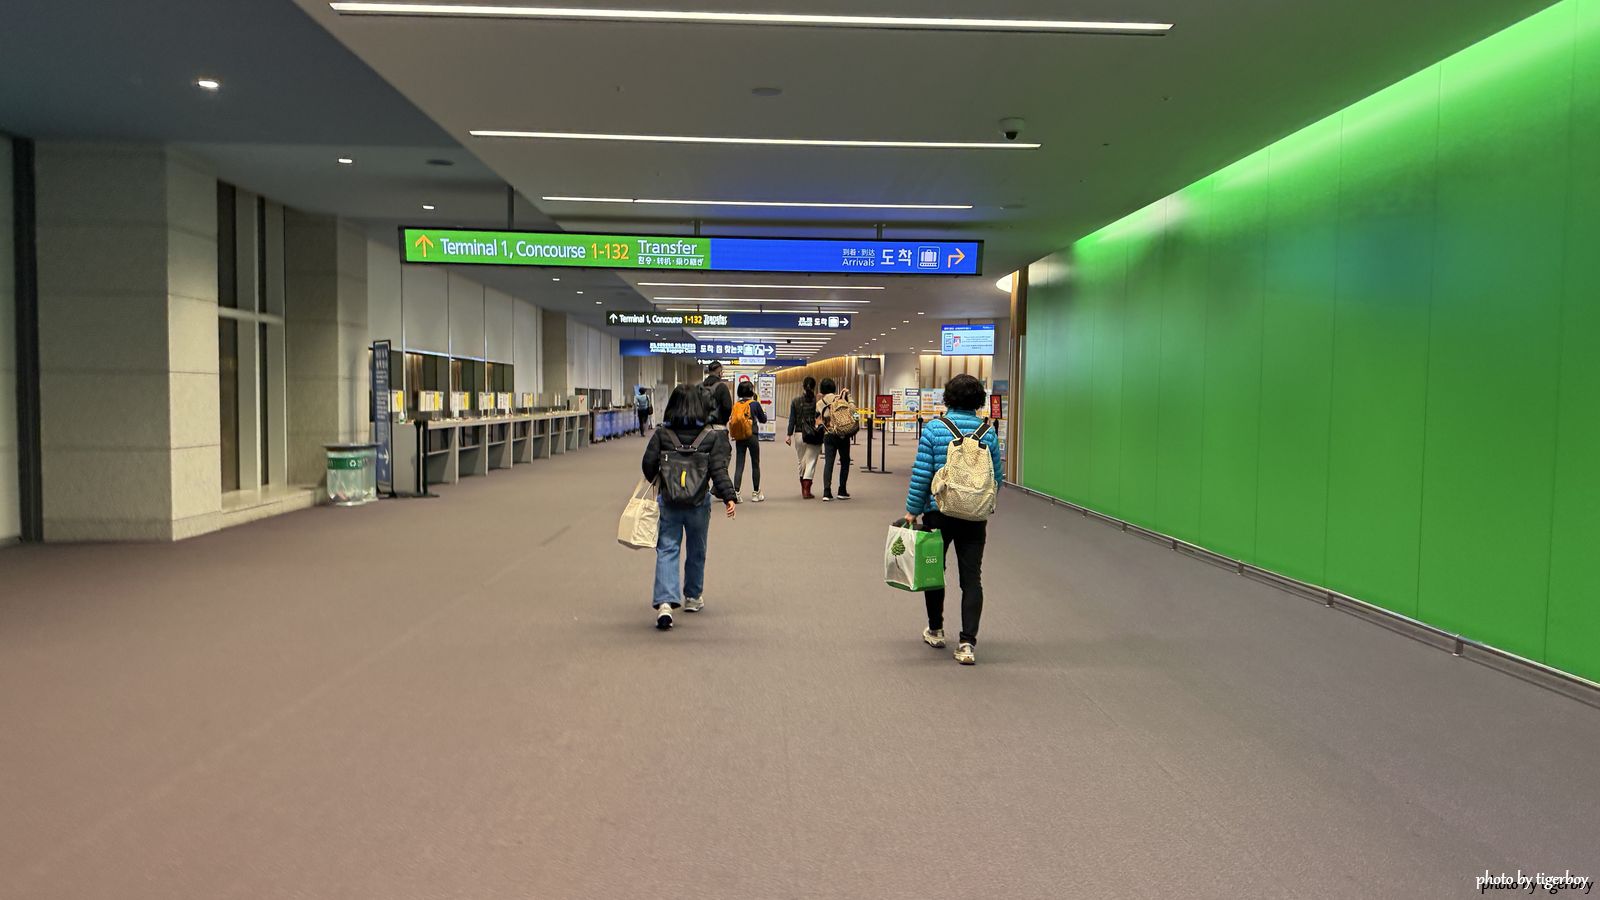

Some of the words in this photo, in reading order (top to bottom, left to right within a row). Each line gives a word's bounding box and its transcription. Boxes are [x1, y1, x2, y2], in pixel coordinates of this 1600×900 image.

[440, 238, 498, 256] Terminal
[501, 240, 514, 259] 1,
[516, 240, 586, 259] Concourse
[591, 242, 629, 260] 1-132
[637, 239, 698, 255] Transfer
[842, 258, 875, 267] Arrivals
[880, 248, 913, 267] 도착
[619, 314, 645, 324] Terminal
[652, 315, 683, 324] Concourse
[684, 315, 703, 325] 1-132
